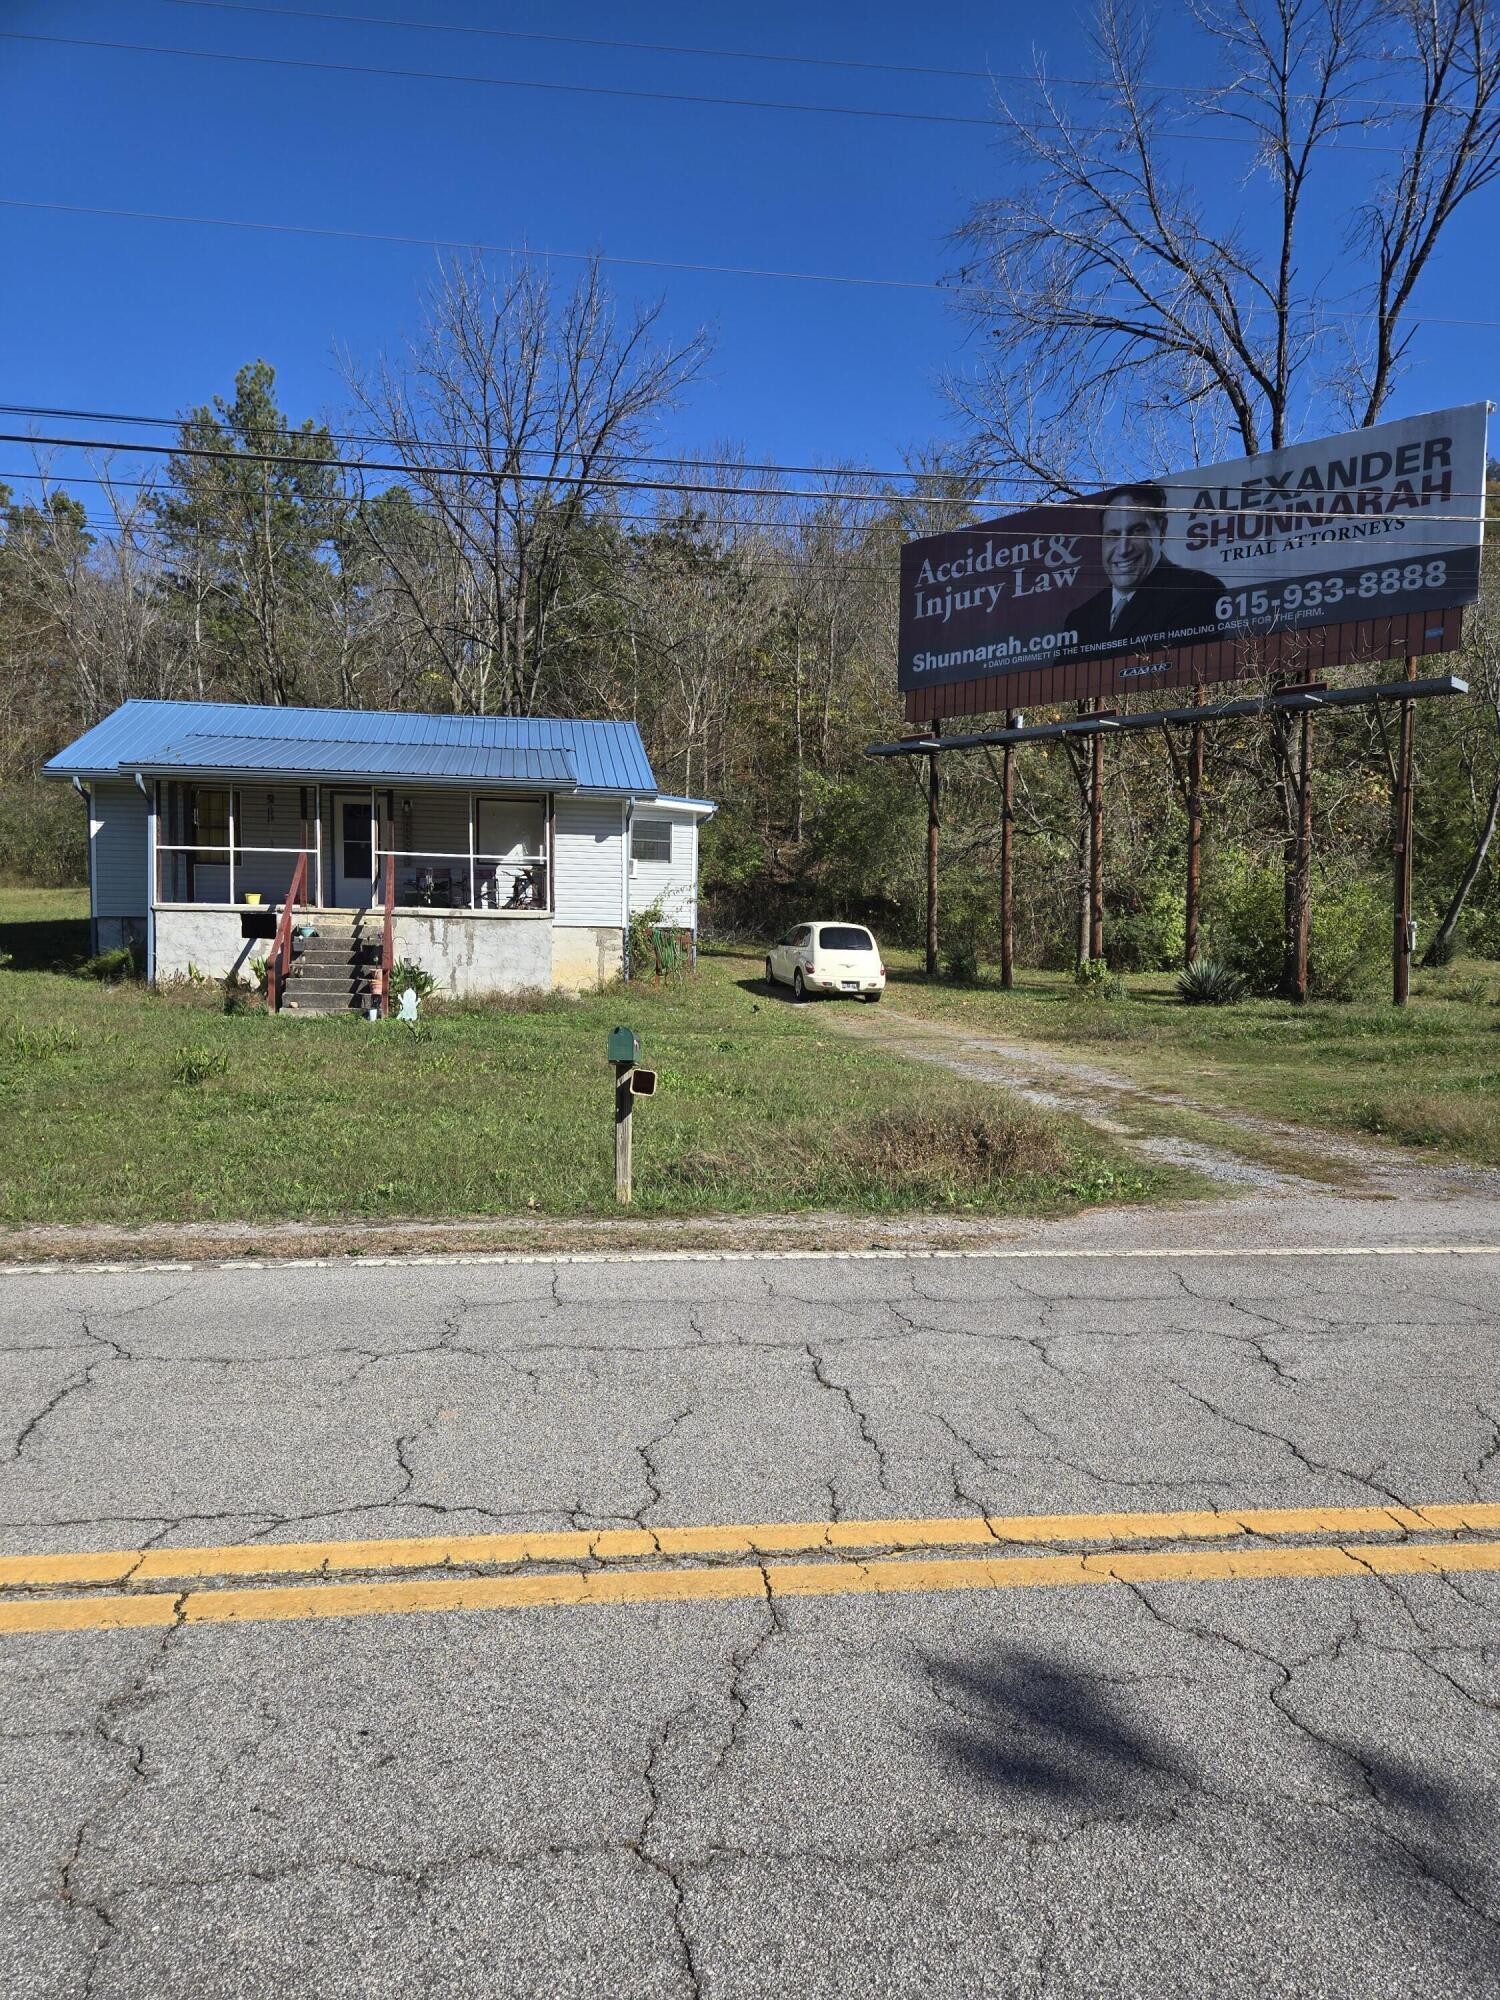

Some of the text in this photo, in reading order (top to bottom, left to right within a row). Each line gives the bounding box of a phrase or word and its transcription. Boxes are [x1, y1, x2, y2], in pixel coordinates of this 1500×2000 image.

[1188, 436, 1453, 520] ALEXANDER
[1185, 470, 1452, 551] SHUNNARAH
[1220, 519, 1406, 563] TRIAL ATTORNEYS
[914, 566, 1079, 623] Injury Law
[1215, 560, 1447, 620] 615-933-8888
[912, 629, 1078, 673] Shunnarah.com
[988, 608, 1325, 668] DAVID GRIMMETT IS THE TENNESSEE LAWYER HANDLING CASES FOR THE FIRM.
